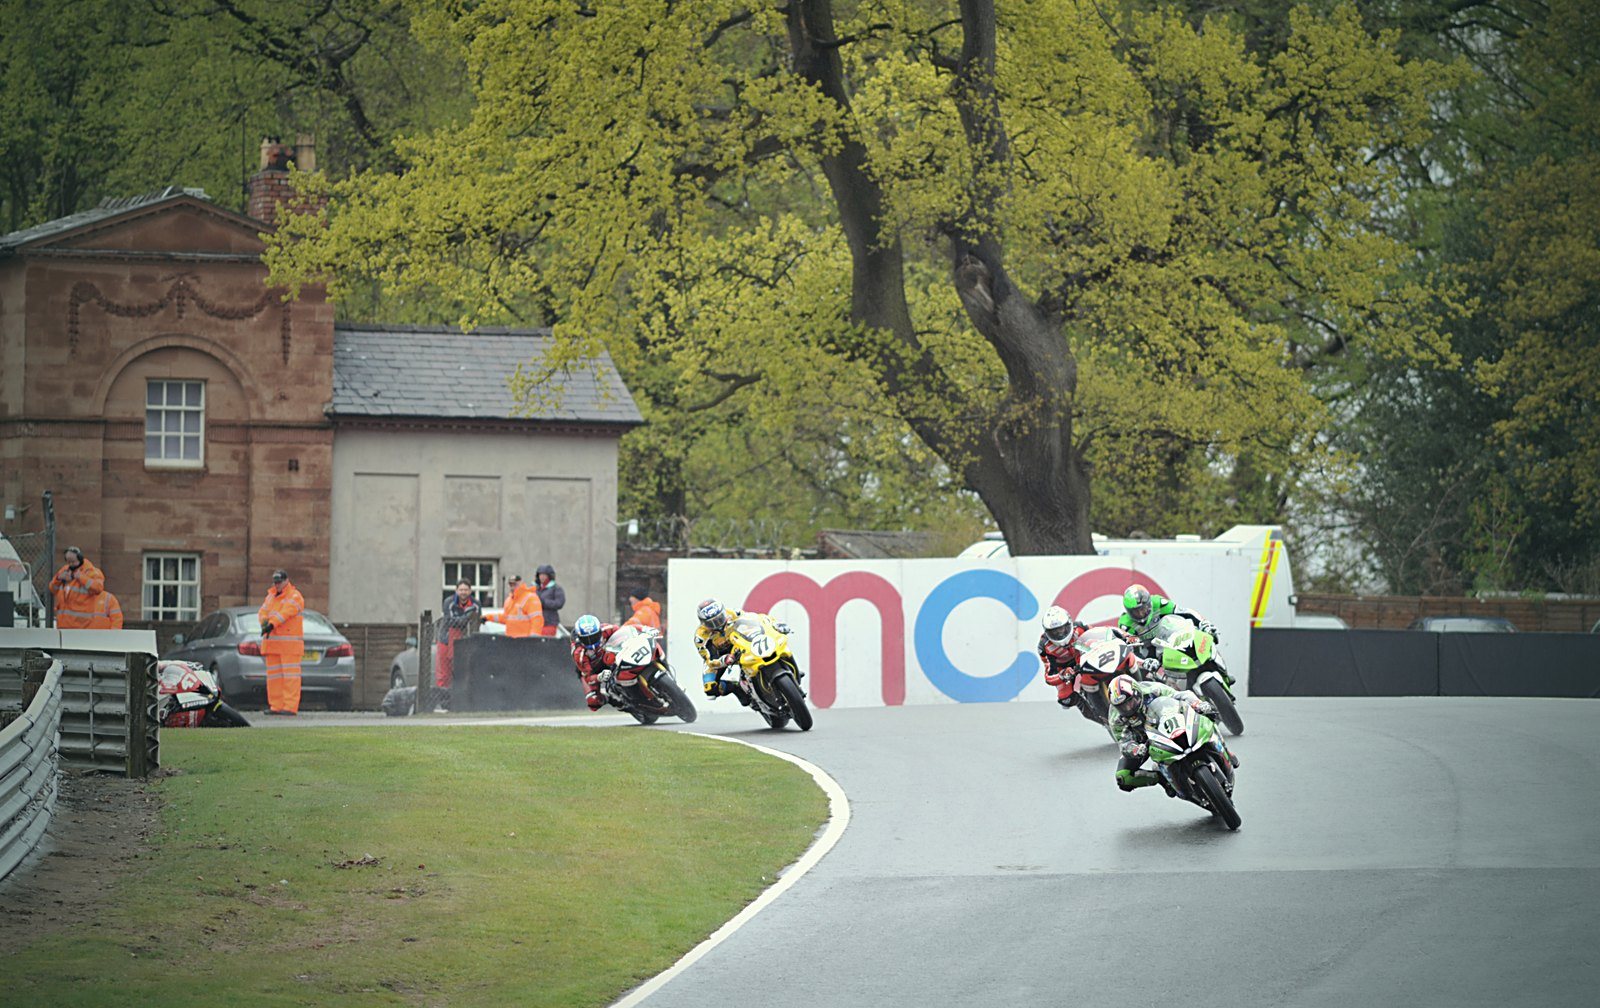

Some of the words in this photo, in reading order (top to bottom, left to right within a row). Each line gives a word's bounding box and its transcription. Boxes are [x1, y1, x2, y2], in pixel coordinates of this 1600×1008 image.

[631, 646, 650, 663] 20
[752, 637, 769, 655] 71
[1098, 650, 1115, 669] 22
[1163, 716, 1181, 734] 91
